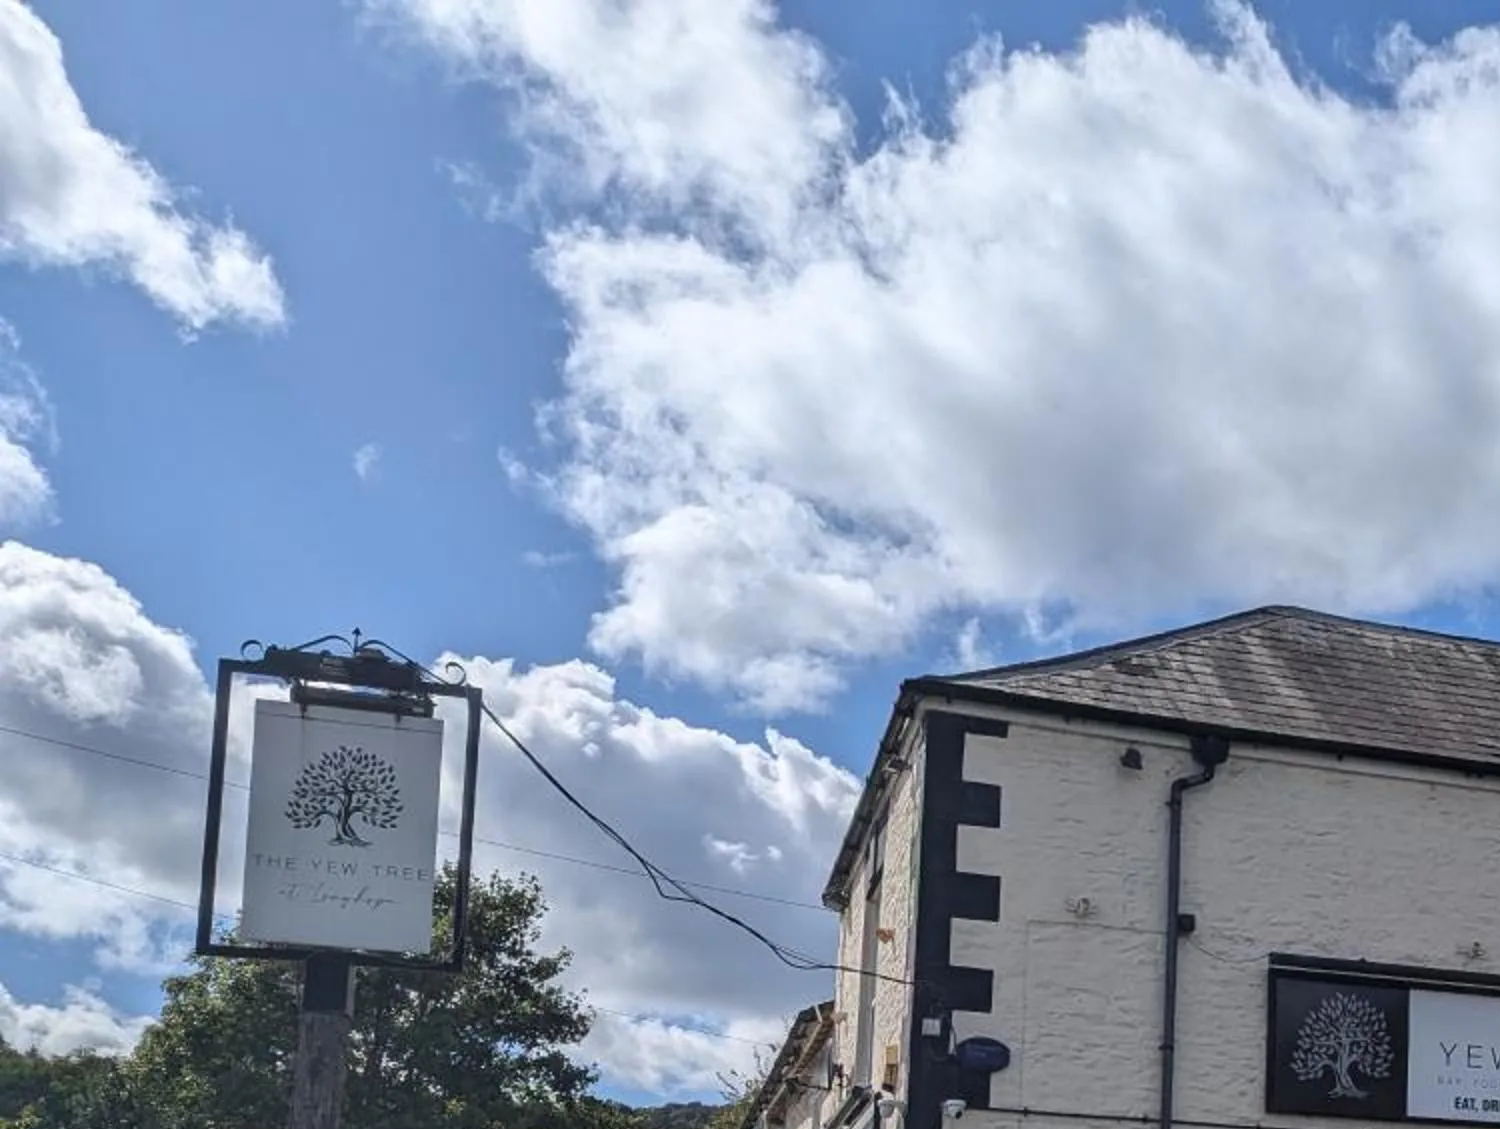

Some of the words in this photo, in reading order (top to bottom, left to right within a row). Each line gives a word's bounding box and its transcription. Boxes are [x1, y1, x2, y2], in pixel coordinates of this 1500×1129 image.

[253, 853, 298, 870] THE
[311, 857, 358, 877] YEW
[373, 865, 430, 882] TREE
[1454, 1096, 1480, 1112] EAT,
